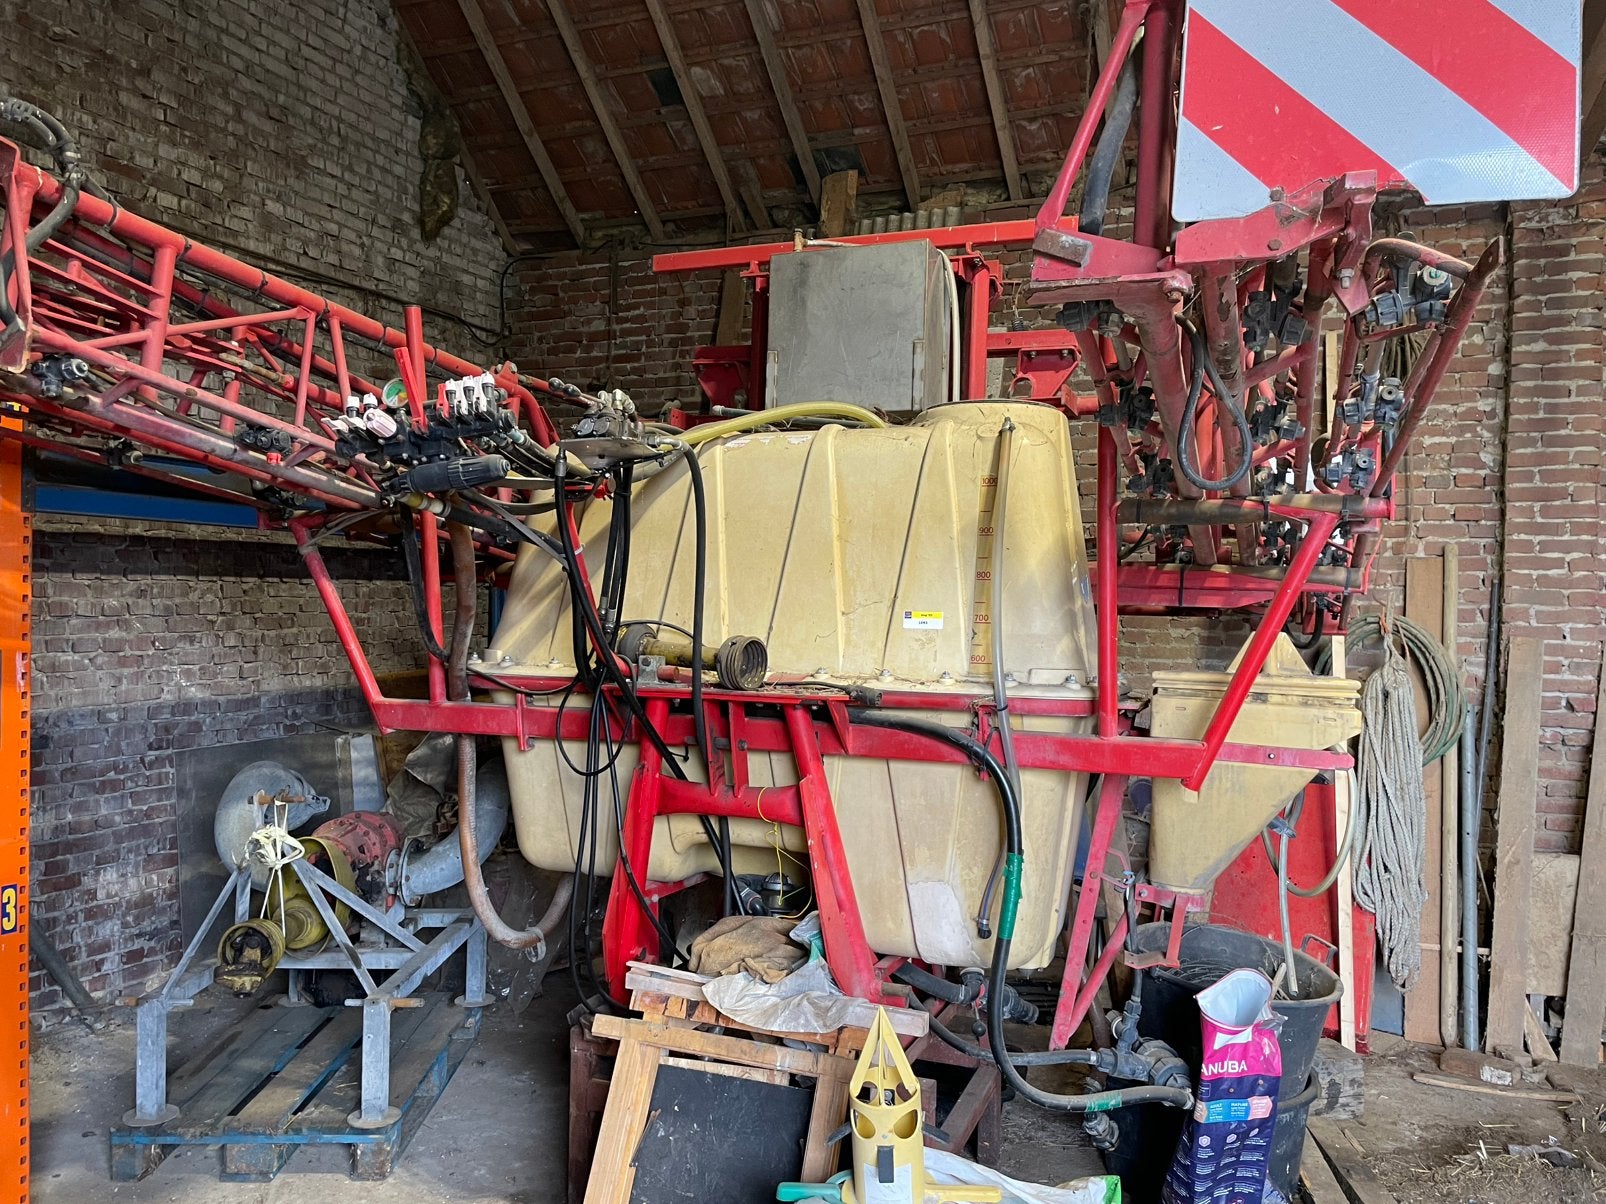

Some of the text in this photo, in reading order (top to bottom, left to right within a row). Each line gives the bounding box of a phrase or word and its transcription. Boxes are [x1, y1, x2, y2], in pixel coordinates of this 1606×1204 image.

[978, 526, 993, 534] 900
[976, 571, 991, 579] 800
[974, 614, 989, 622] 700
[970, 654, 986, 662] 600
[2, 888, 16, 931] 3
[1201, 1060, 1248, 1076] ANUBA
